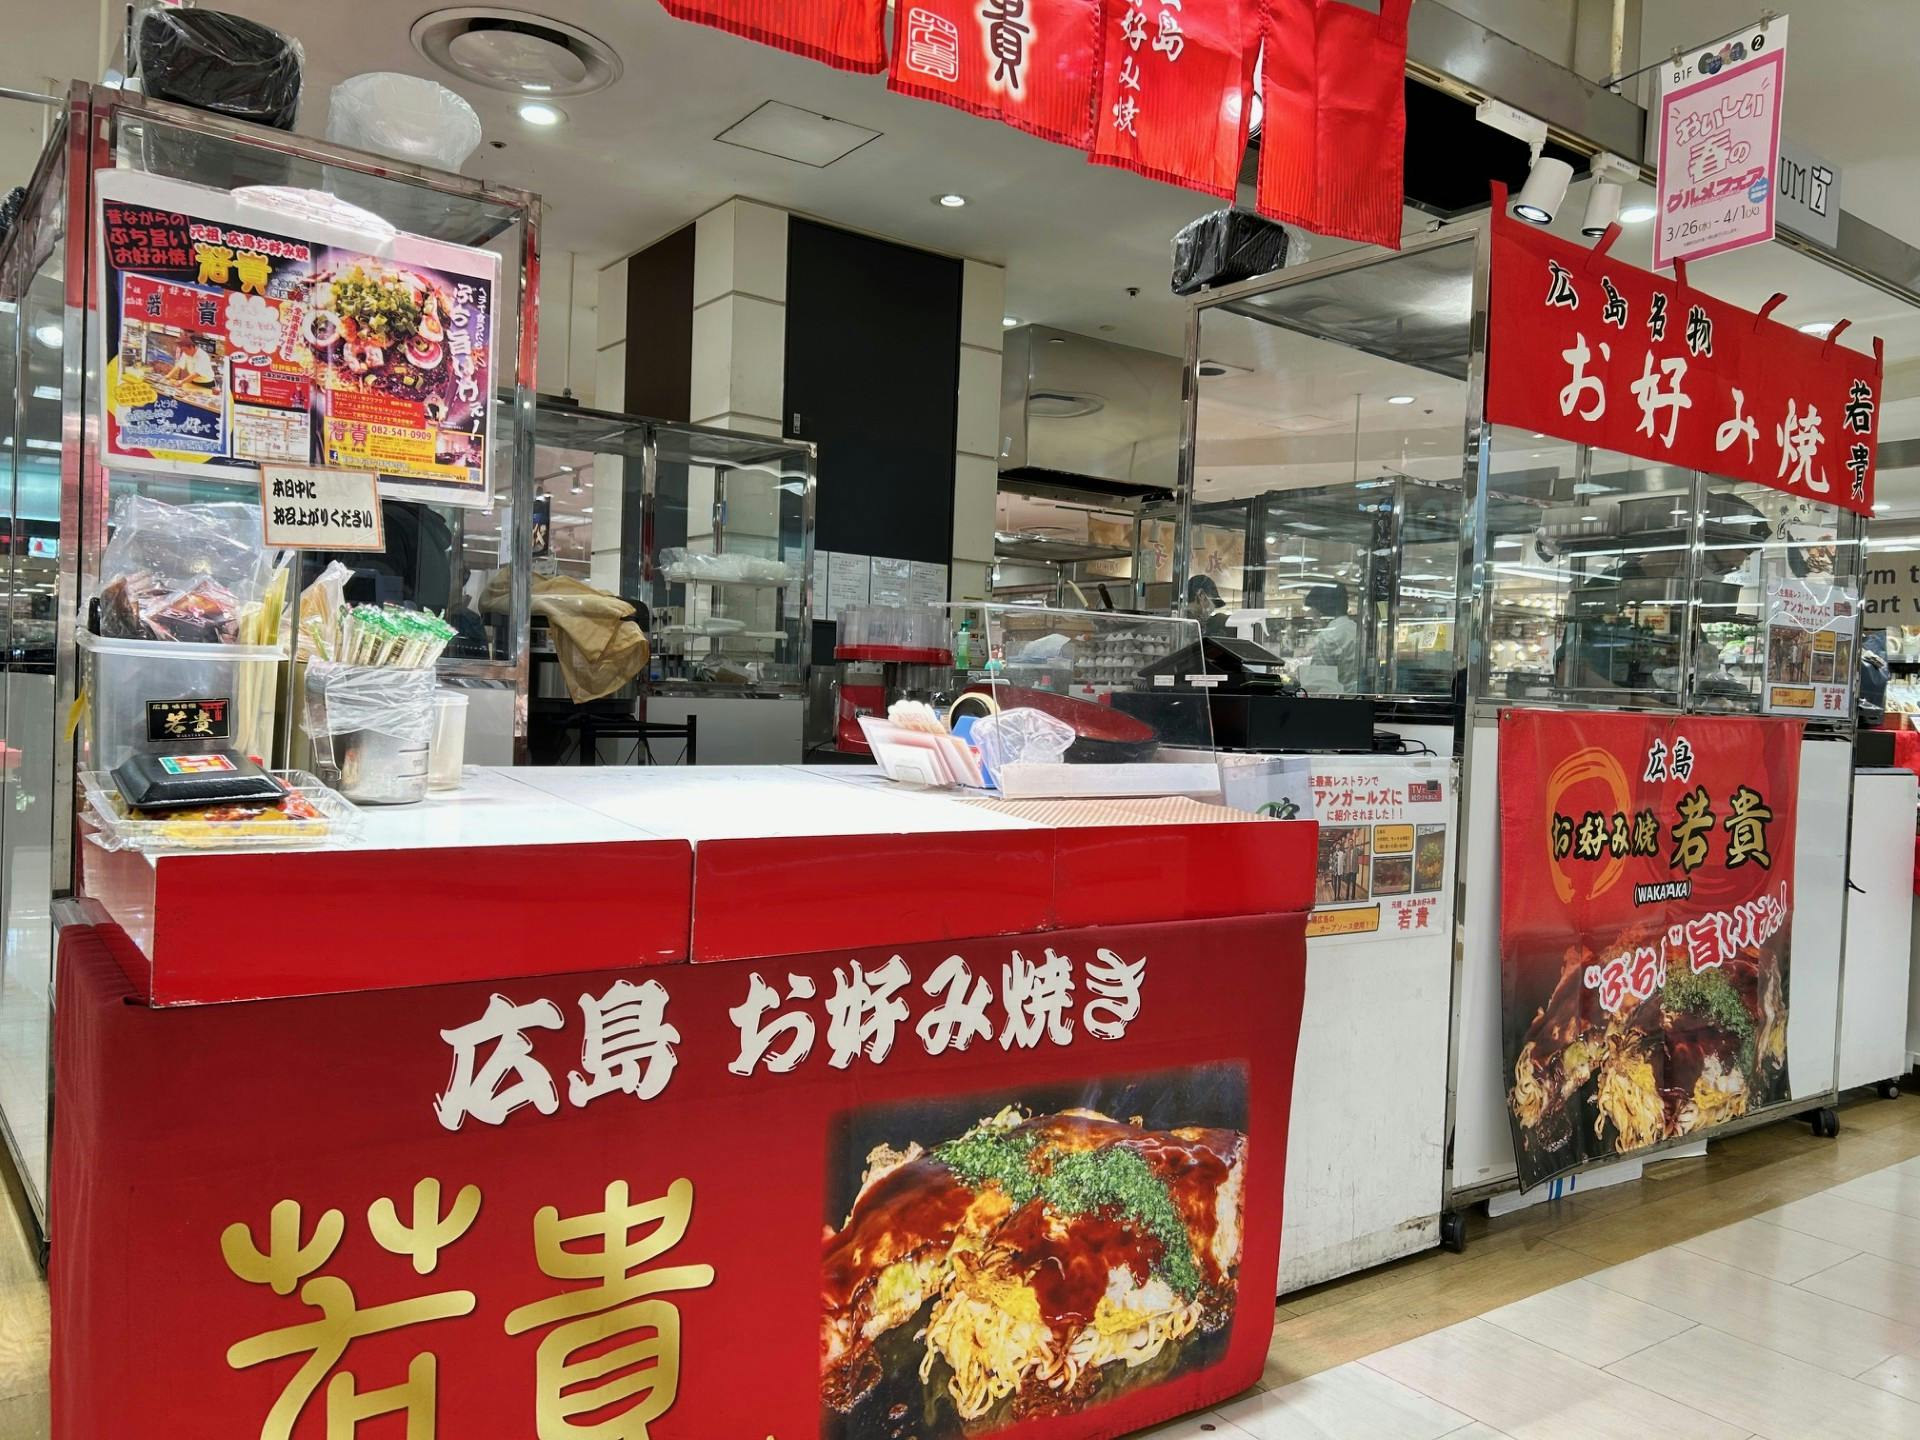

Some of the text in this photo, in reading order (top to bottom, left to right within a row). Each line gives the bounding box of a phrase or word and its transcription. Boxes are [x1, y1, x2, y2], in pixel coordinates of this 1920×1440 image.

[1151, 0, 1185, 62] 島
[1112, 0, 1148, 138] 好み焼
[1673, 66, 1693, 84] B1F
[1675, 93, 1764, 147] おいしい
[1688, 128, 1751, 184] 春の
[1667, 166, 1765, 214] グルメフェア
[106, 208, 185, 226] 昔ながらの
[109, 229, 188, 247] ぶち旨い
[195, 243, 272, 296] 若貴
[1545, 259, 1713, 358] 広島名物
[1559, 331, 1830, 494] お好み焼
[1842, 378, 1875, 503] 若貴
[272, 478, 317, 499] 本日中に
[273, 505, 373, 529] お召上がりください
[1643, 736, 1694, 783] 広島
[1314, 788, 1404, 808] アンガールズに
[1326, 808, 1404, 821] に紹介されました!!
[1551, 785, 1773, 872] お好み焼 若貴
[1634, 879, 1692, 906] (WAKATAKA)
[1397, 906, 1431, 930] 若貴
[433, 945, 1148, 1132] 広島 お好み焼き
[220, 1177, 716, 1440] 若貴
